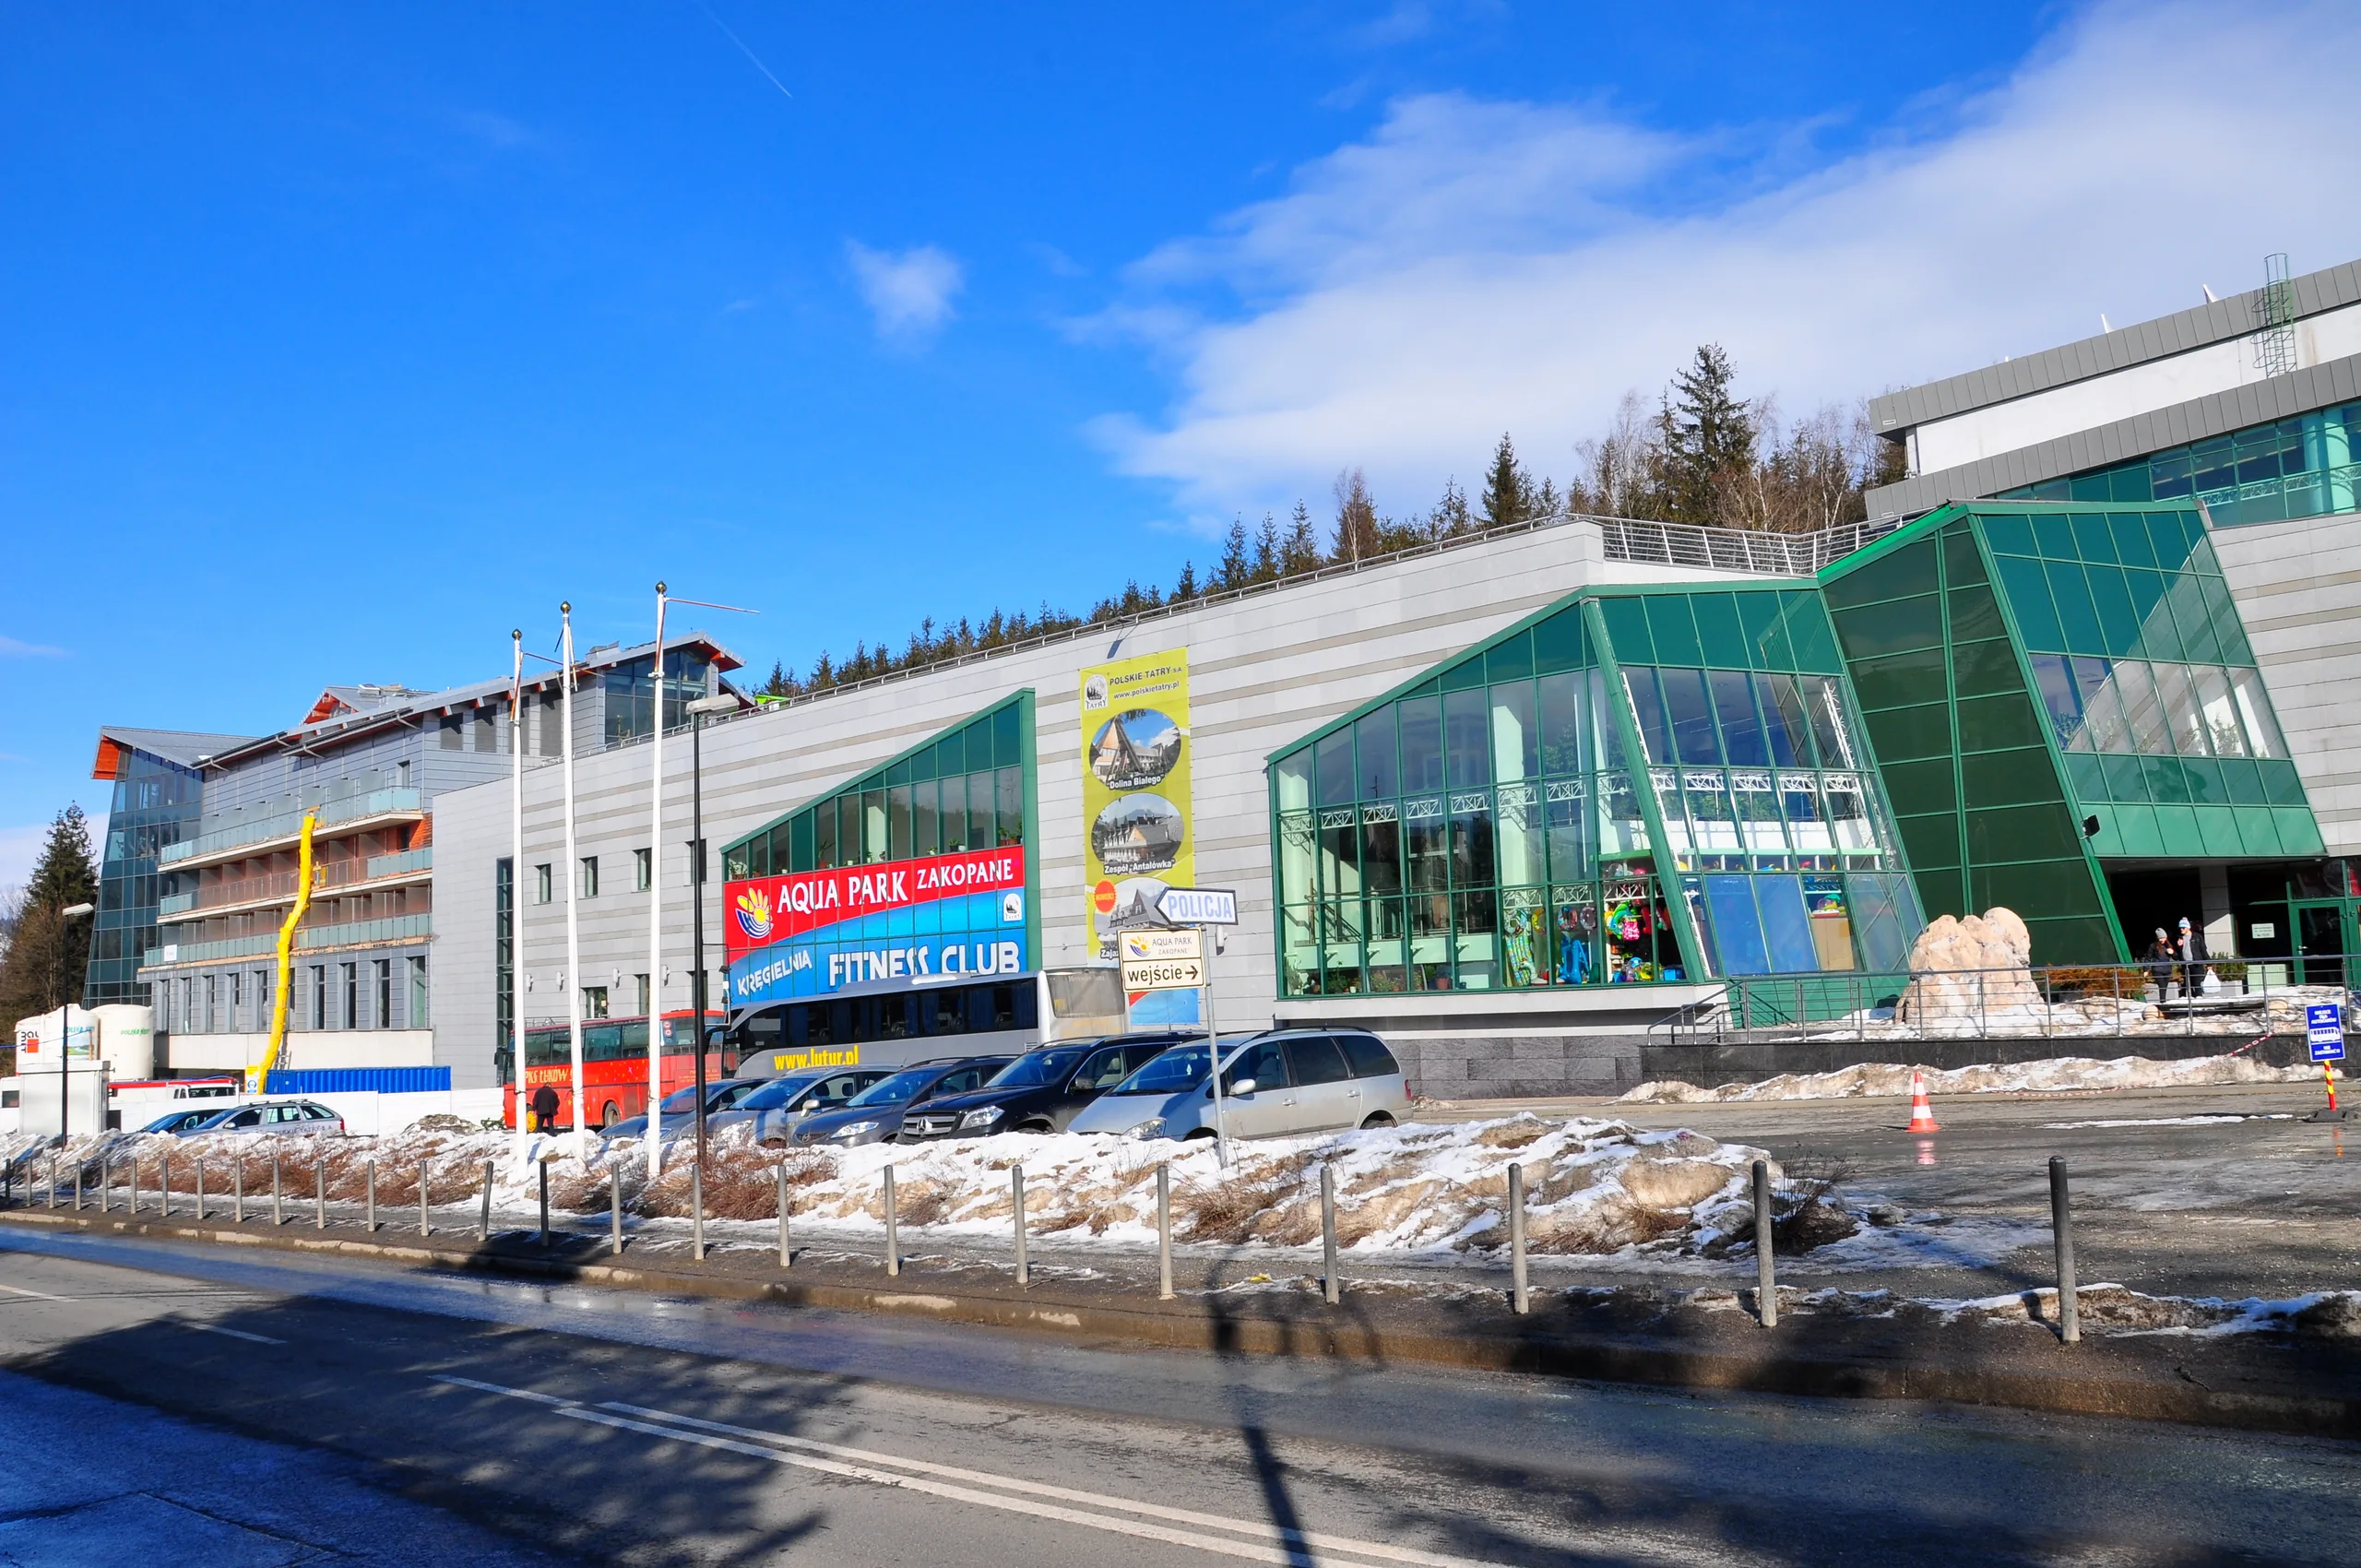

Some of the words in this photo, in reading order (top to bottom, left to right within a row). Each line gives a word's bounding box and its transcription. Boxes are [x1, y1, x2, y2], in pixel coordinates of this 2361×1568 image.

[1109, 672, 1143, 685] POLSKIE
[1145, 666, 1171, 679] TATRY
[1114, 681, 1180, 699] www.polskietatry.pl
[777, 879, 840, 914] AQUA
[848, 871, 908, 907] PARK
[917, 859, 1013, 889] ZAKOPANE
[1167, 895, 1232, 918] POLICJA
[1152, 938, 1172, 946] AQUA
[1174, 937, 1192, 945] PARK
[829, 945, 929, 986] FITNESS
[942, 941, 1020, 974] CLUB
[1100, 949, 1119, 960] Zaja
[738, 949, 813, 997] KRĘGIELNIA
[1127, 964, 1182, 985] wejście
[774, 1045, 859, 1070] www.lutur.pl
